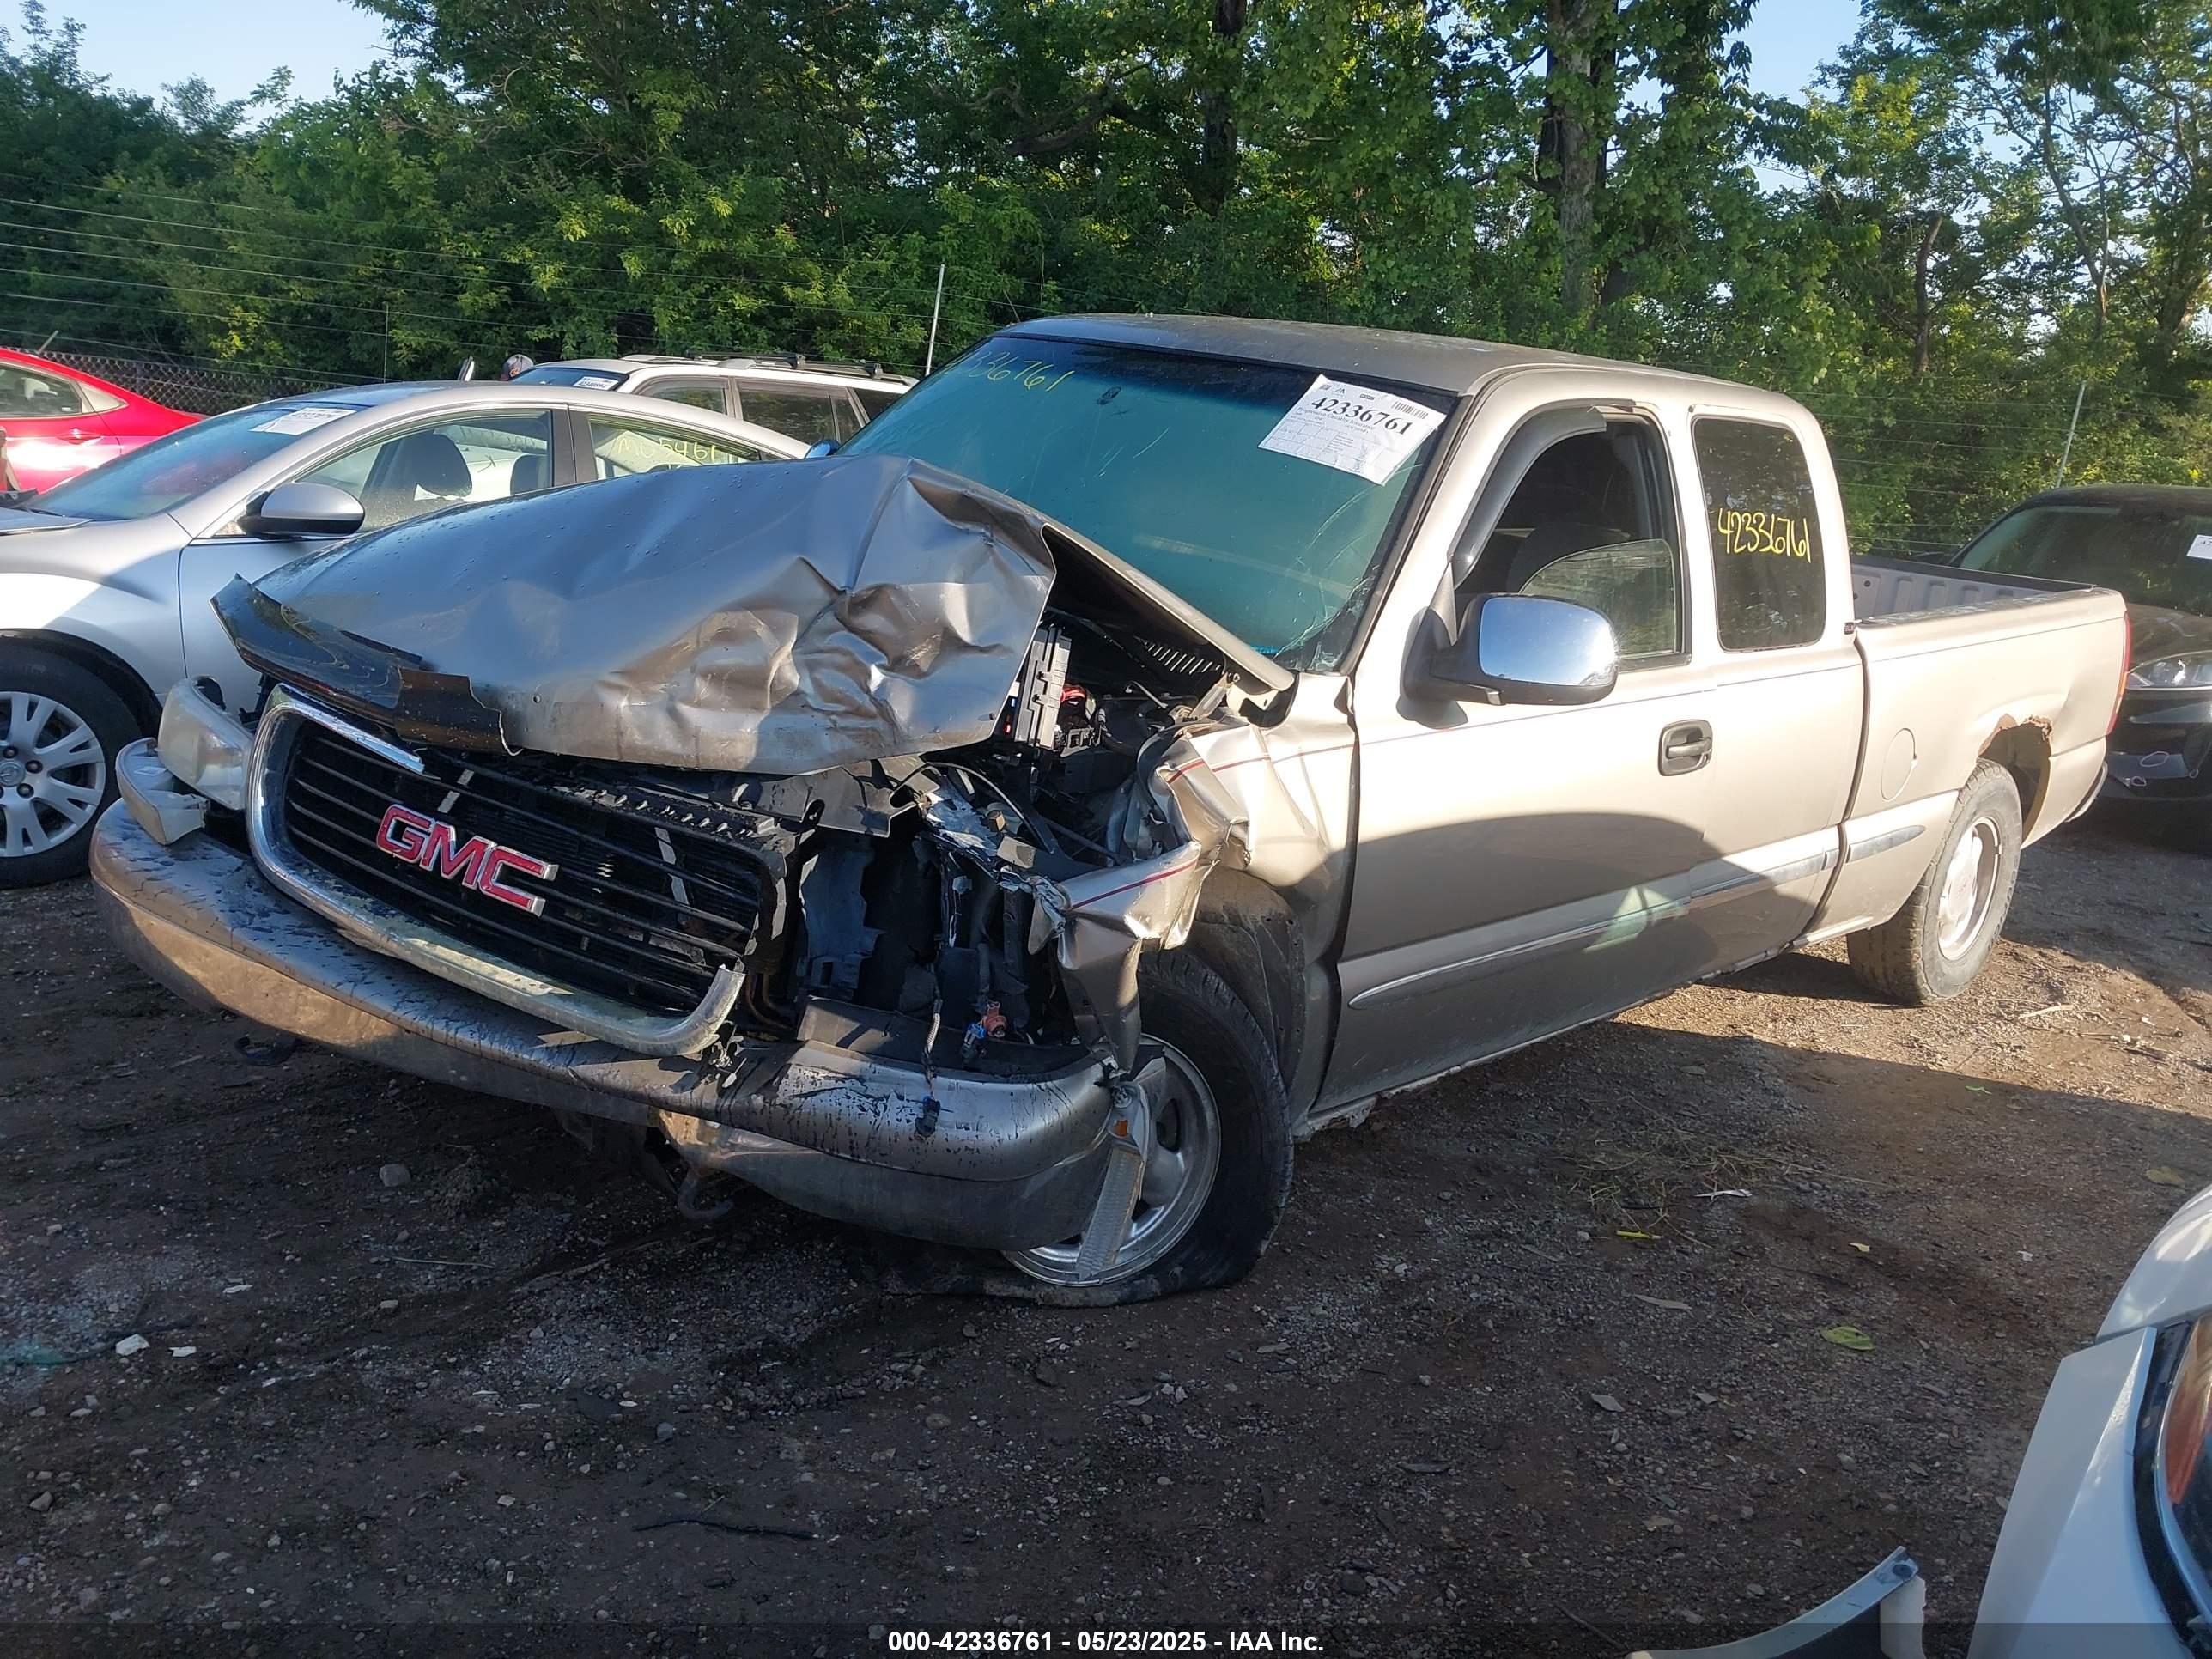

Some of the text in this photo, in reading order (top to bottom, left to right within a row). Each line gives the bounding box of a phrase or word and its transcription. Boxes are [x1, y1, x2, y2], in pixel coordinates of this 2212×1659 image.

[1311, 397, 1413, 435] 42336761
[1718, 507, 1811, 563] 42336761
[376, 803, 559, 917] GMC
